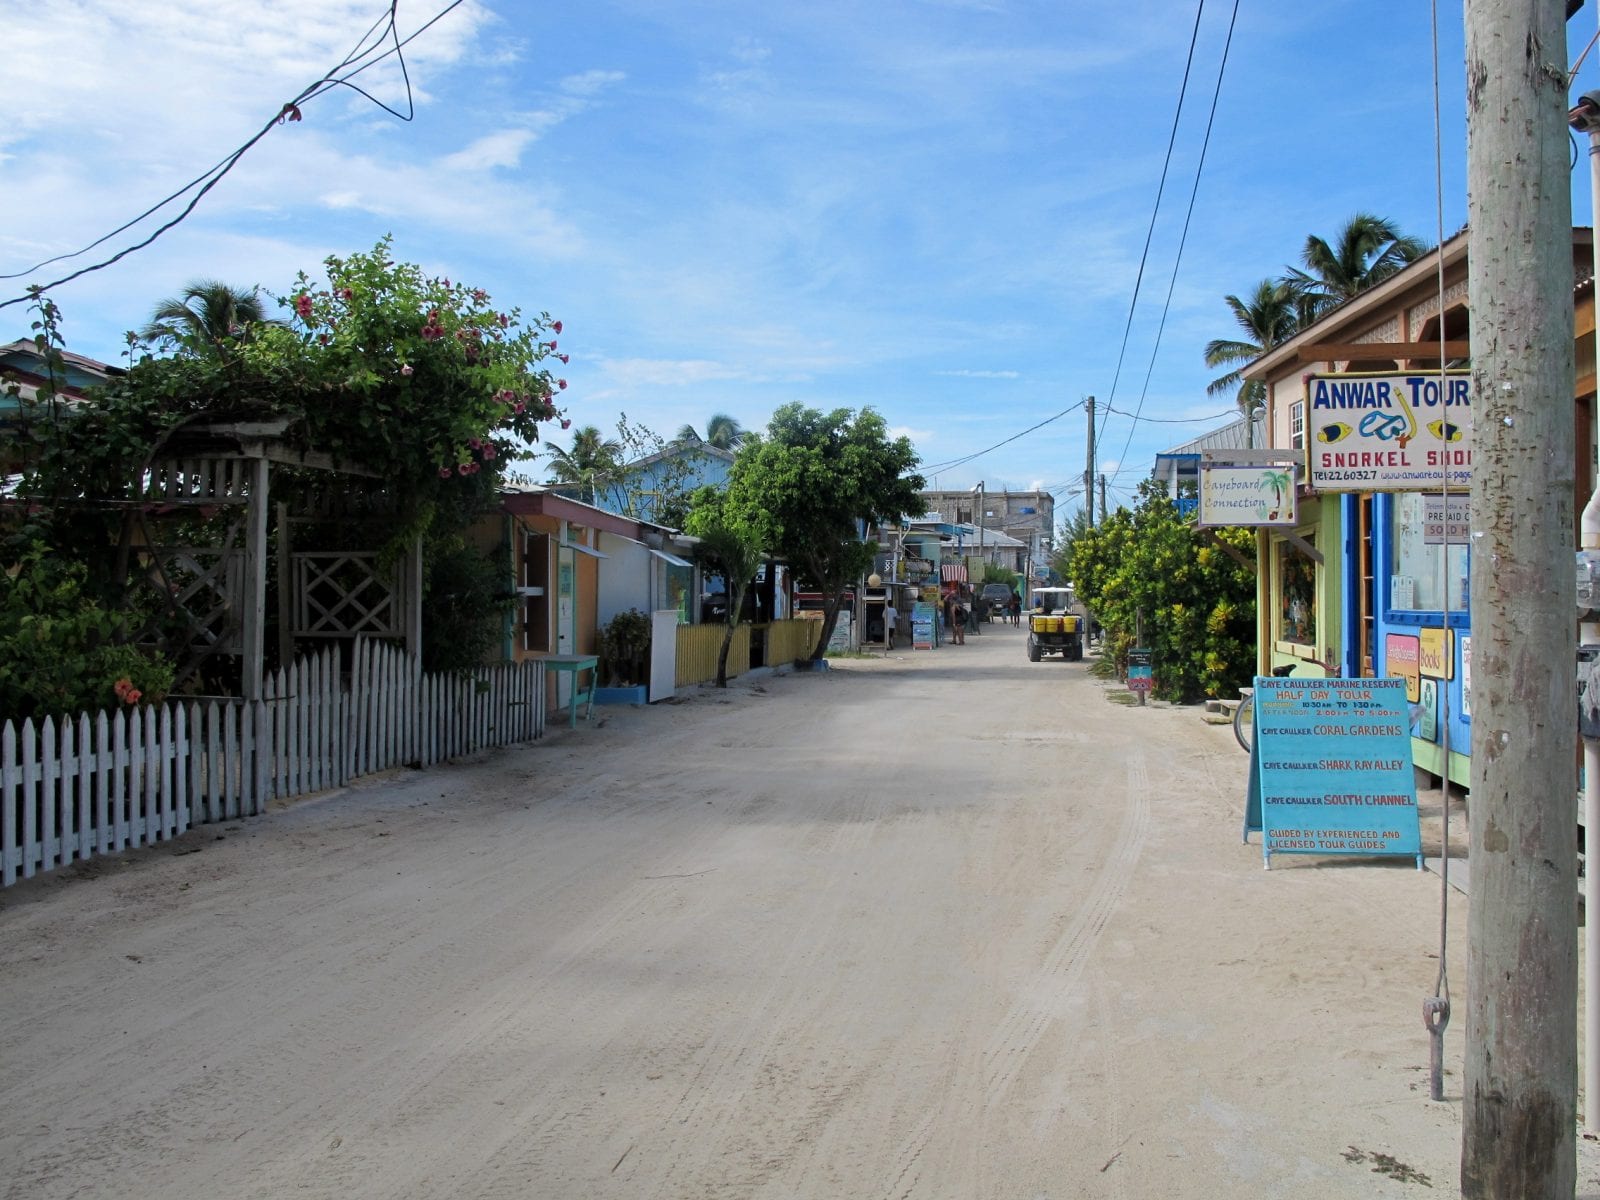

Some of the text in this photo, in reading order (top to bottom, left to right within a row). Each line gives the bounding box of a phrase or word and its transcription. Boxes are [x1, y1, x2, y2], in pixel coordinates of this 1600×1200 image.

[1313, 380, 1392, 409] ANWAR
[1322, 451, 1411, 468] SNORKEL
[1203, 478, 1260, 496] Cayeboard
[1205, 496, 1266, 508] Connection
[1420, 648, 1440, 669] Books
[1260, 680, 1281, 689] CAYE
[1284, 680, 1325, 689] CAULKER
[1327, 680, 1360, 689] MARINE
[1362, 680, 1401, 689] RESERVE
[1276, 690, 1373, 700] HALF DAY TOUR
[1337, 701, 1348, 709] TO
[1314, 725, 1349, 736] CORAL
[1349, 725, 1402, 736] GARDENS
[1264, 760, 1403, 770] CAYE CAULKER SHARK RAY ALLEY
[1265, 794, 1415, 806] CAYE CAULKER SOUTH CHANNEL
[1268, 830, 1400, 839] GUIDED BY EXPERIENCED AND
[1268, 840, 1386, 849] LICENSED TOUR GUIDES
